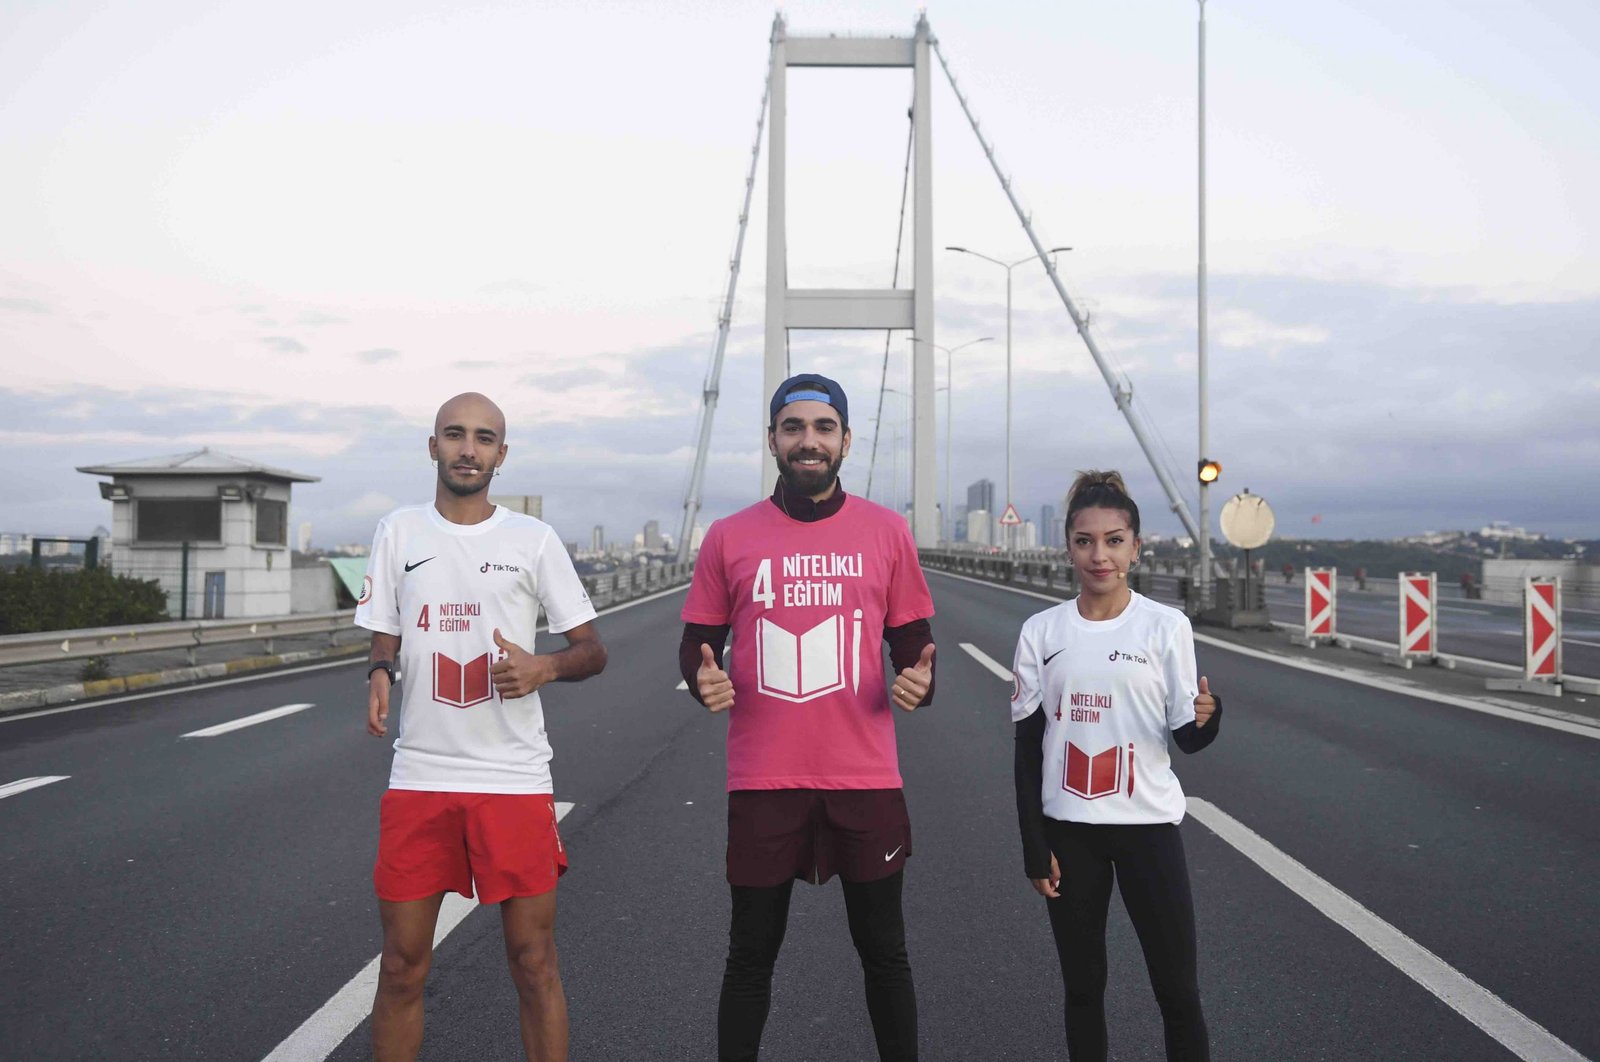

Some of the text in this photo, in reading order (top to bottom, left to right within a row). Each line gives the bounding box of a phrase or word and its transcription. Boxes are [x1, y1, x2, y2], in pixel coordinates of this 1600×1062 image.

[783, 552, 863, 577] NİTELİKLİ
[752, 558, 776, 609] 4
[783, 580, 843, 607] EĞİTİM
[416, 604, 431, 632] 4
[439, 601, 481, 616] NİTELİKLİ
[439, 617, 470, 632] EĞİTİM
[1070, 692, 1112, 709] NİTELİKLİ
[1070, 707, 1100, 723] EĞİTİM
